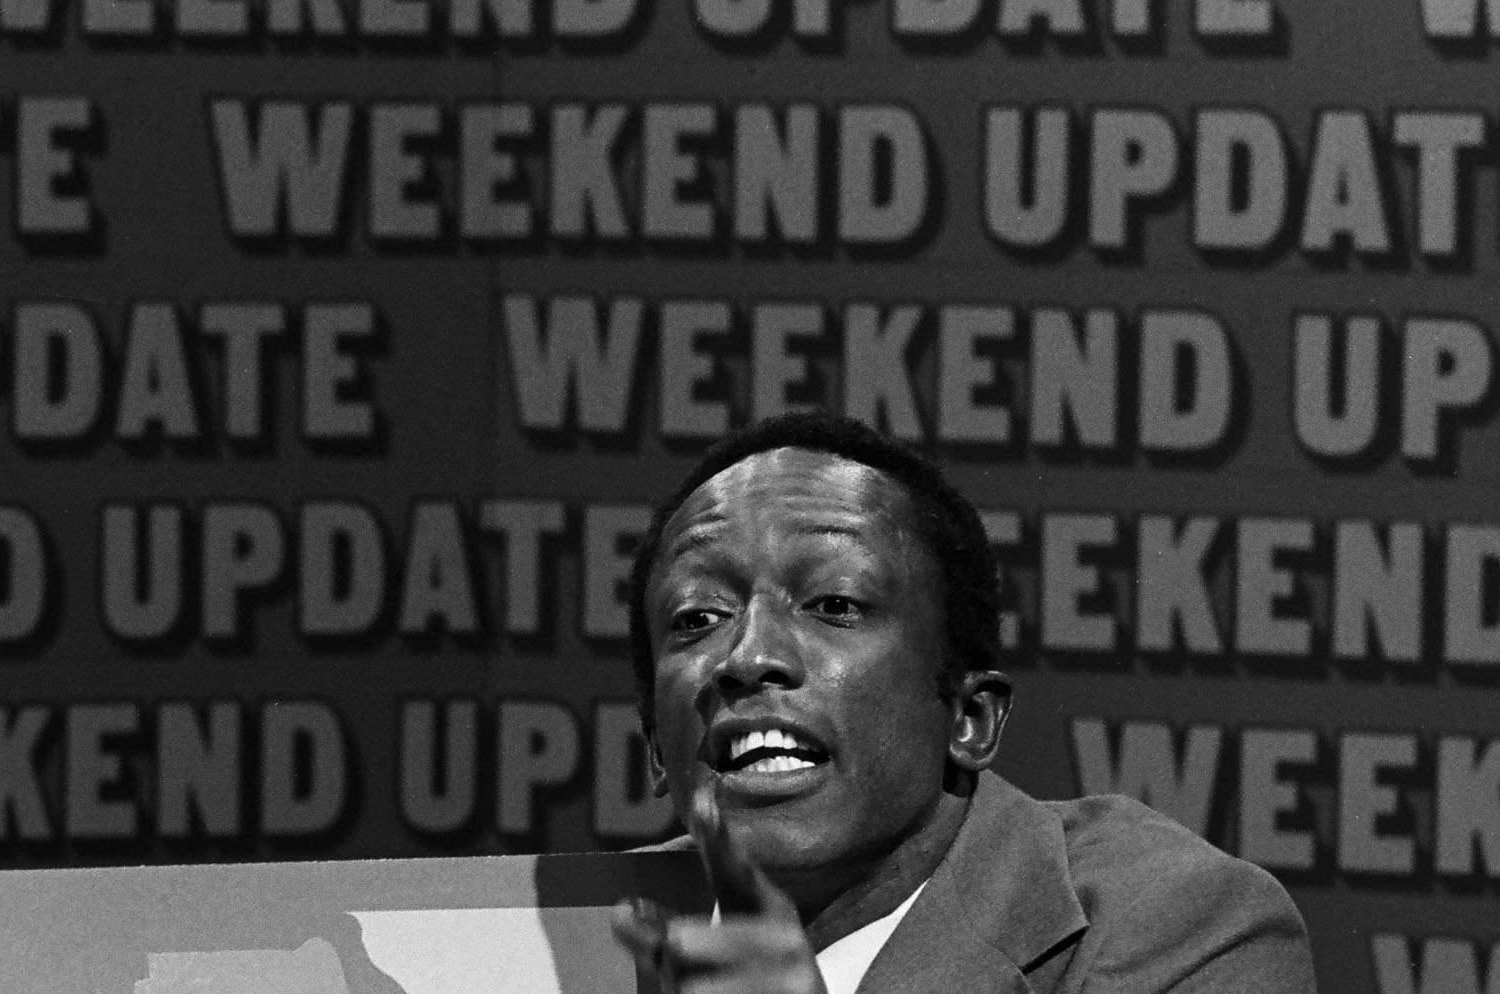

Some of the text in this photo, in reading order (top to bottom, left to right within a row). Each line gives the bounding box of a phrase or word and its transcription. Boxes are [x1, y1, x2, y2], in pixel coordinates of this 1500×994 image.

[210, 98, 929, 243] WEEKEND
[504, 296, 1235, 451] WEEKEND
[101, 502, 650, 640] UPDATE
